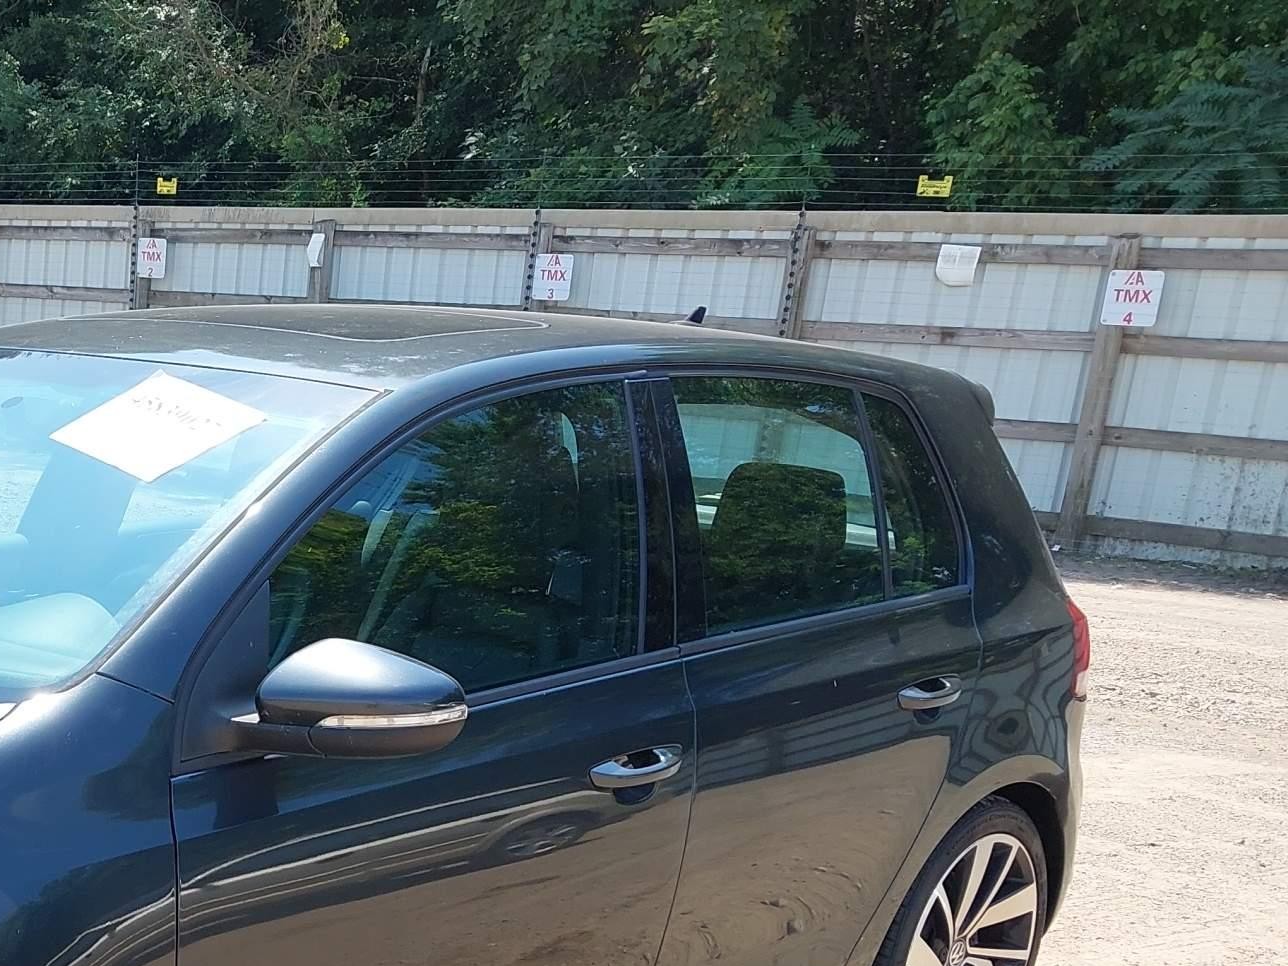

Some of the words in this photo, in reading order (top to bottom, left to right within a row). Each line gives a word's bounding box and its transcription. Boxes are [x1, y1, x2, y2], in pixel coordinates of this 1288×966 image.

[141, 250, 162, 262] TMX
[147, 267, 154, 277] 2
[540, 269, 567, 281] TMX
[547, 288, 554, 299] 3
[1114, 288, 1153, 304] TMX
[1122, 311, 1133, 325] 4
